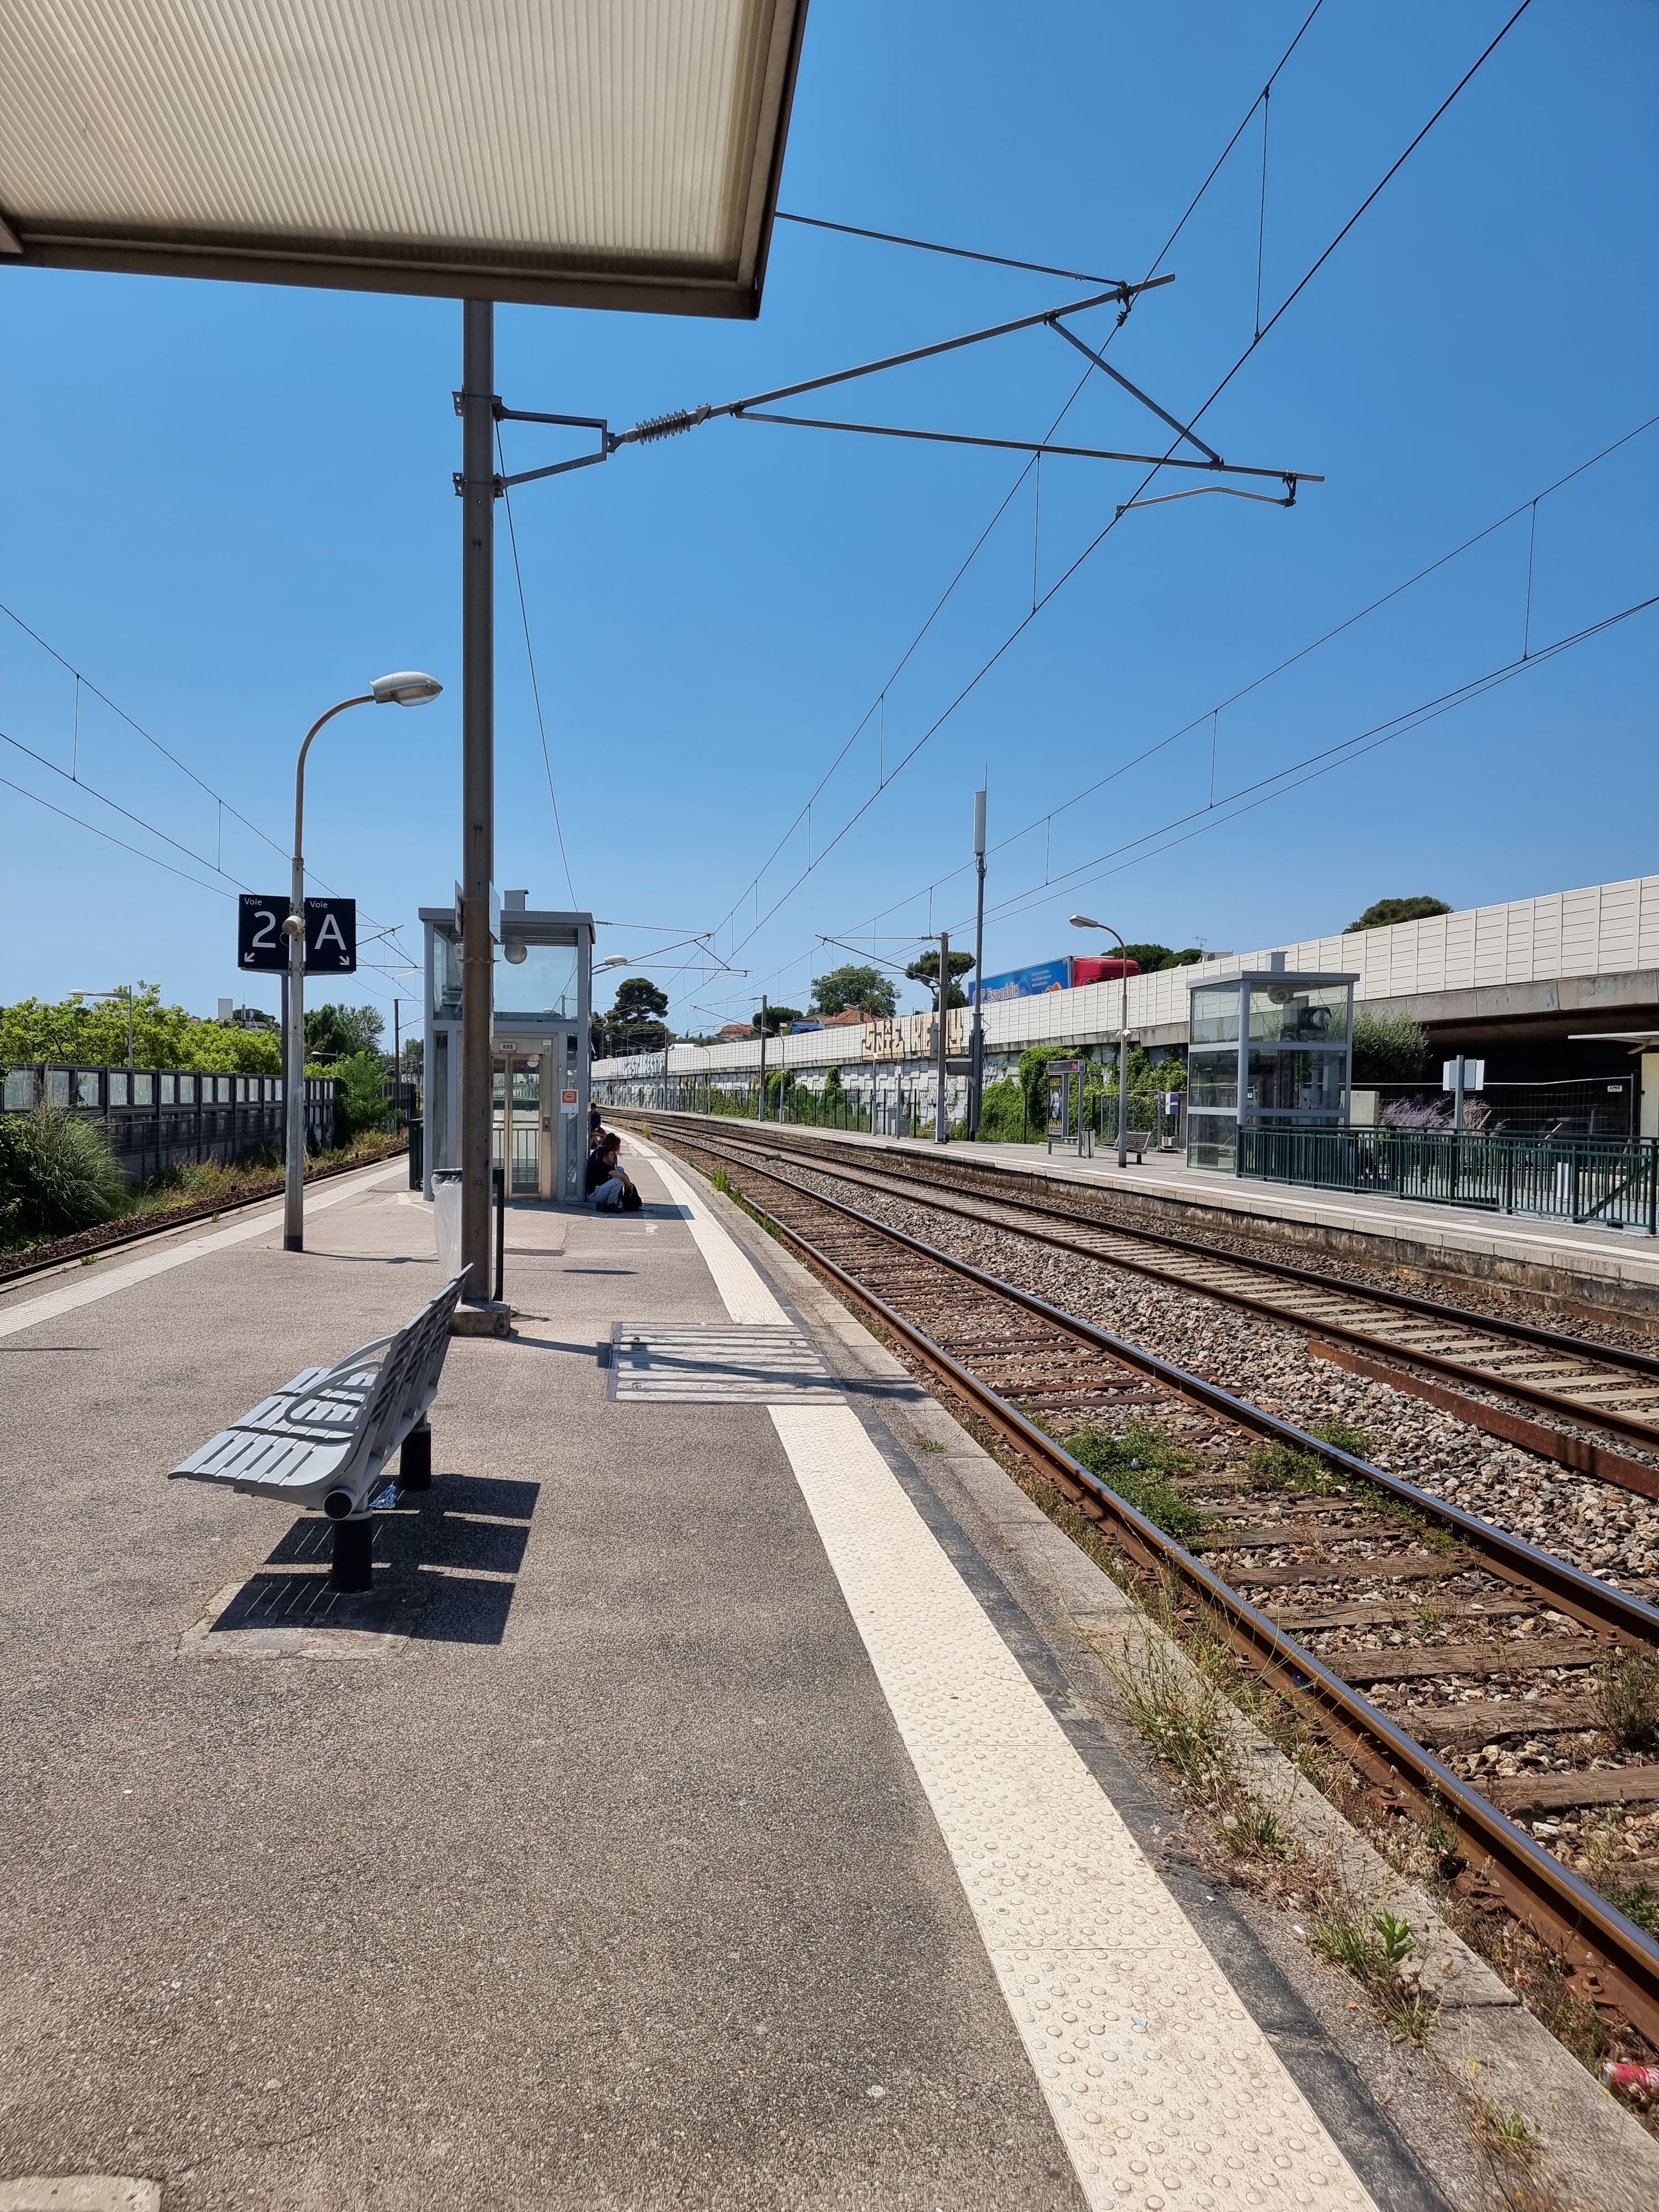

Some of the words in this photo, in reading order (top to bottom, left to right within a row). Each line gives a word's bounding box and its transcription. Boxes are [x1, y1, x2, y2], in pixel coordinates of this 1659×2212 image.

[244, 898, 263, 906] Voie
[309, 900, 328, 909] Voie
[252, 911, 276, 948] 2
[314, 914, 347, 951] A
[987, 982, 1019, 1002] Esperidio
